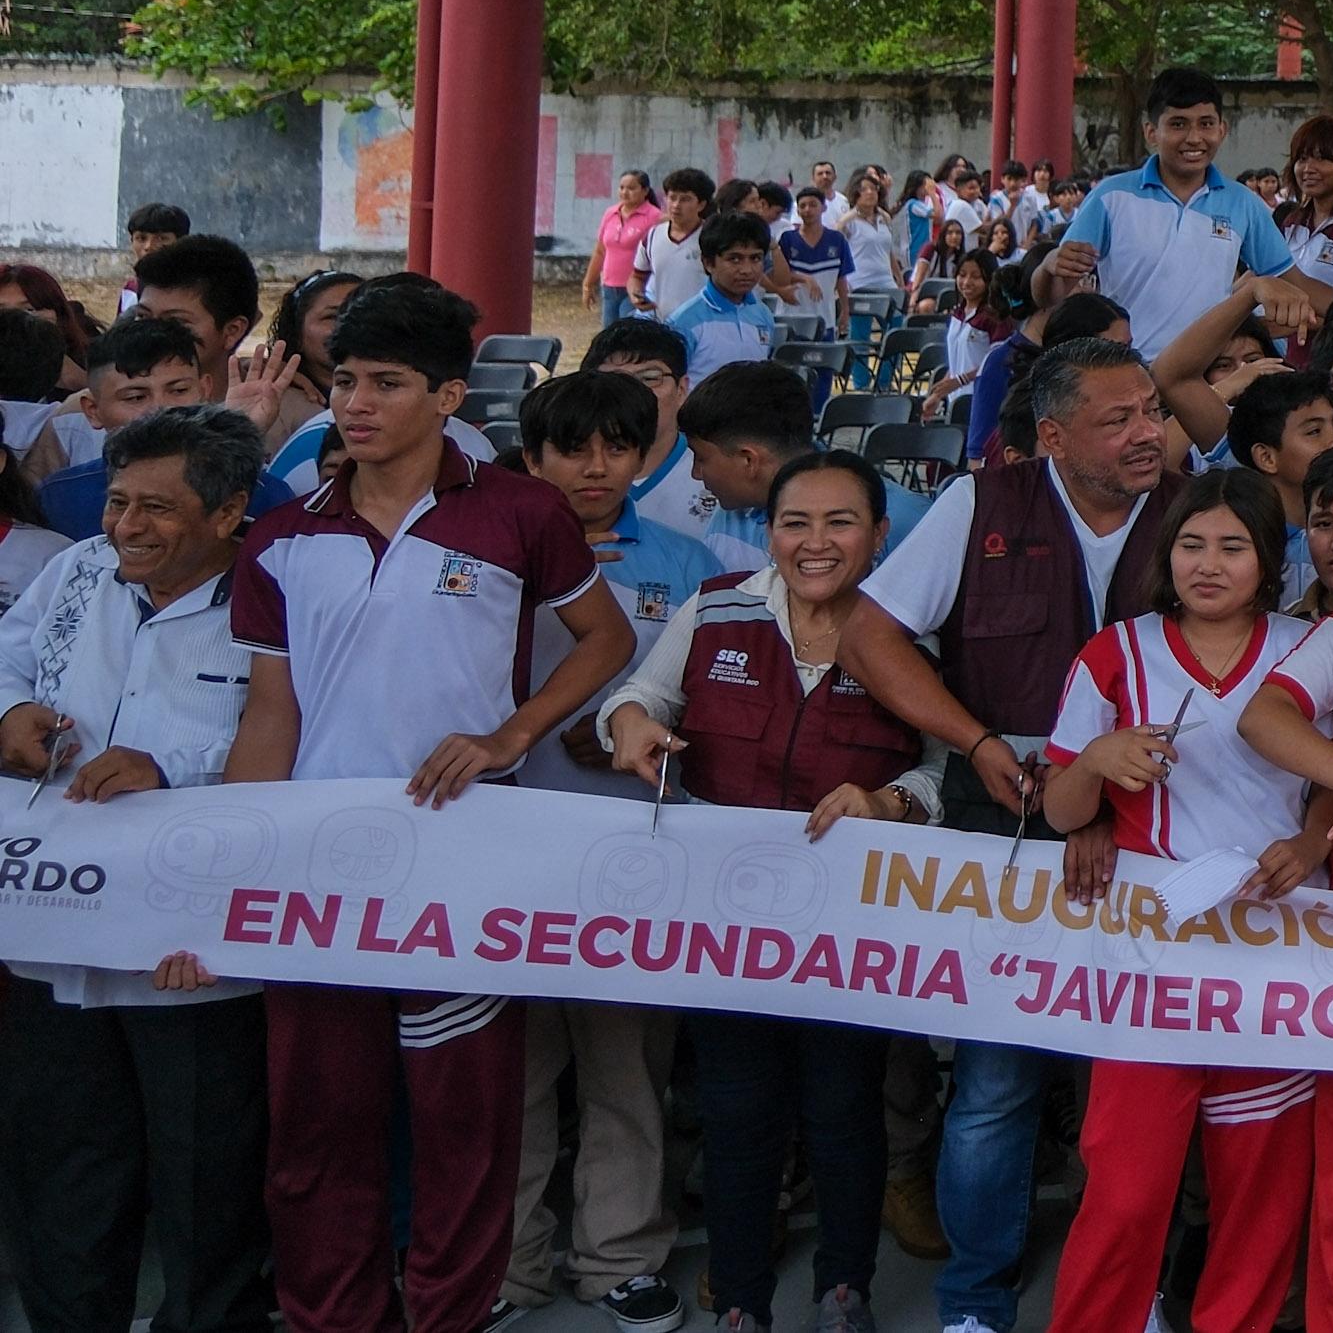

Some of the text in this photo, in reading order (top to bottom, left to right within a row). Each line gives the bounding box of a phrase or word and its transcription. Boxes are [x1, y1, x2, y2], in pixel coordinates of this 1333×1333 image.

[716, 649, 749, 667] SEQ
[223, 888, 343, 948] EN
[357, 898, 455, 959] LA
[473, 906, 969, 1006] SECUNDARIA
[990, 952, 1243, 1033] “JAVIER
